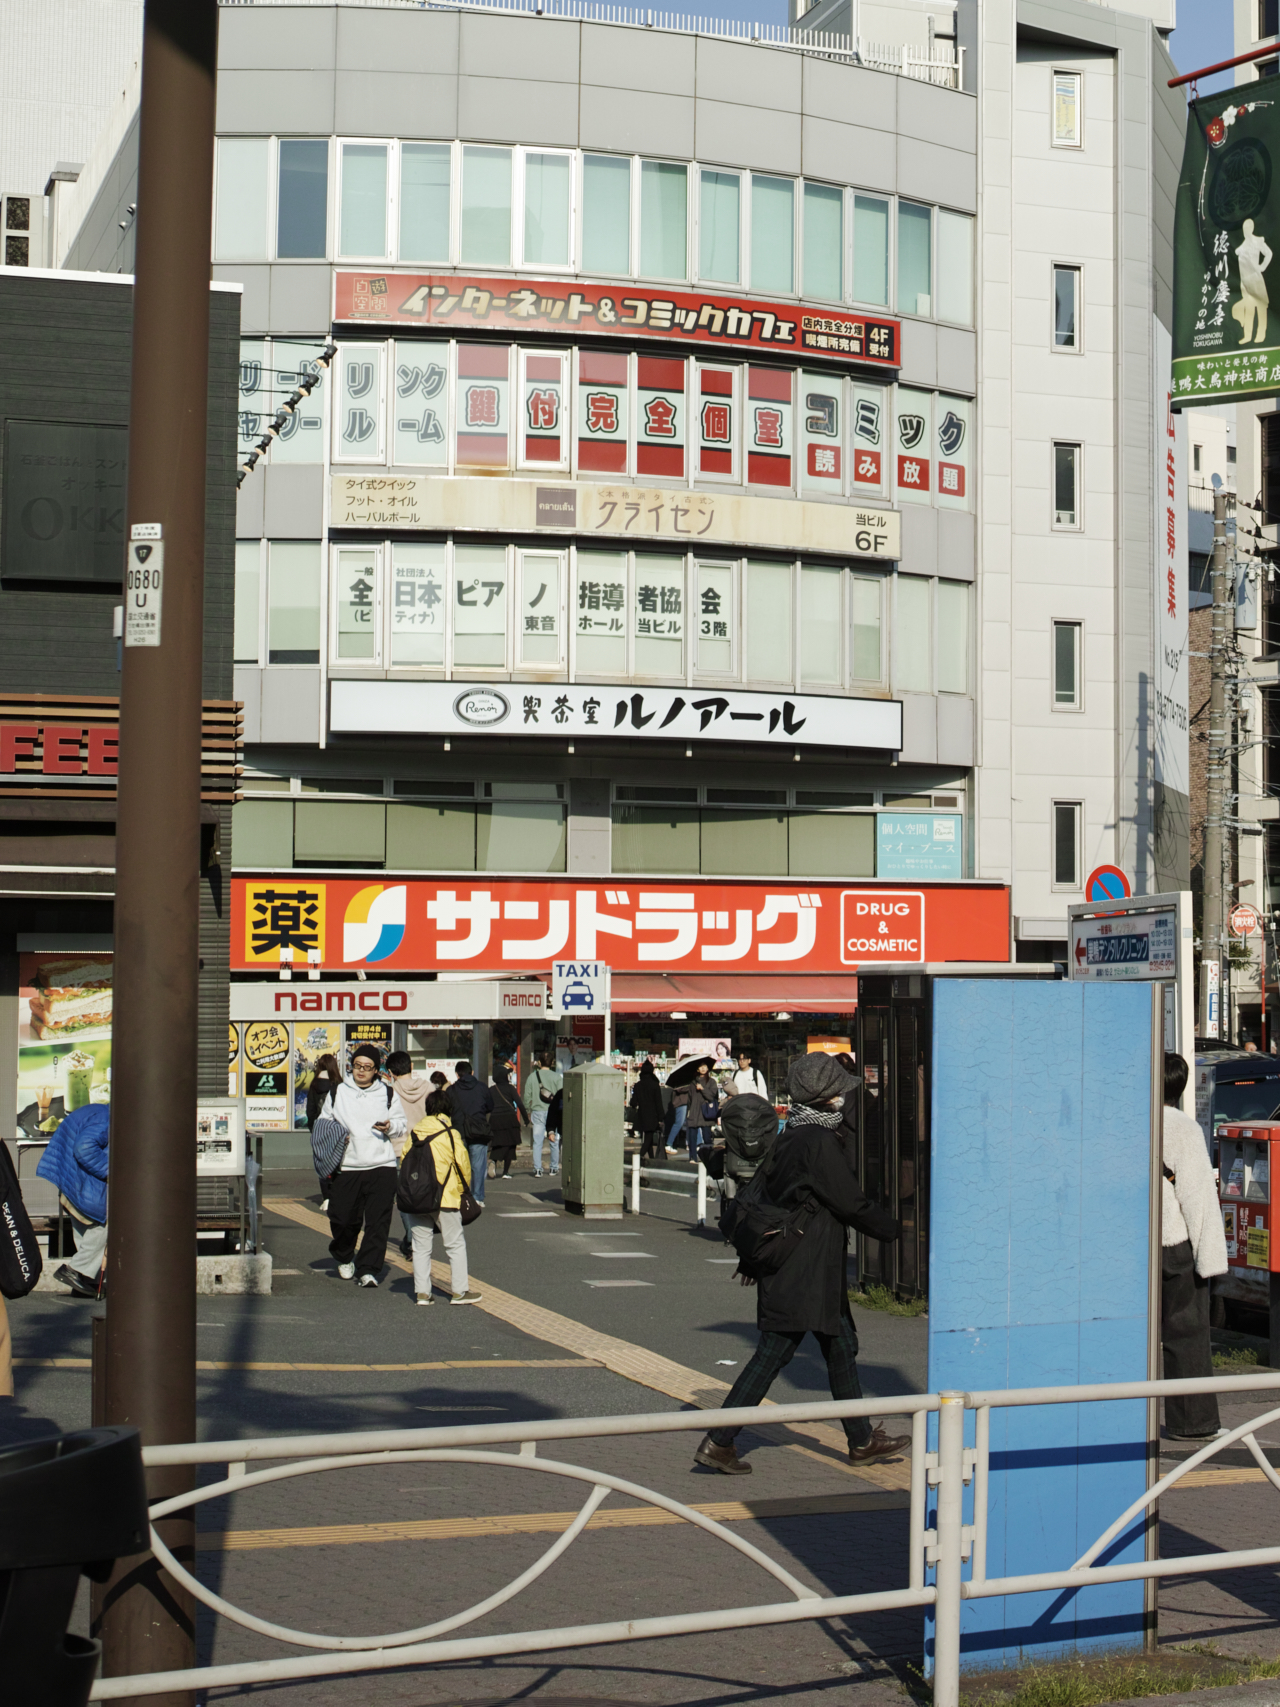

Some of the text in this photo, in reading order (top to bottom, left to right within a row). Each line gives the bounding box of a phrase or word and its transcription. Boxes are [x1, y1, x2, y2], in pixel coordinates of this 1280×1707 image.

[870, 327, 889, 343] 4F
[1194, 332, 1223, 341] YOSHINOBU
[869, 343, 889, 358] 受付
[1193, 339, 1223, 348] TOKUGAWA
[466, 385, 783, 449] 鍵付完全個室
[805, 393, 966, 456] コミック
[814, 448, 959, 492] 読み放題
[345, 479, 417, 492] タイ式クイック
[345, 495, 418, 508] フット・オイル
[345, 511, 421, 525] ハーバルボール
[595, 501, 715, 536] クライセン
[855, 513, 887, 529] 当ビル
[854, 530, 888, 553] 6F
[139, 549, 148, 558] 17
[127, 569, 160, 590] 0680
[135, 593, 147, 608] U
[349, 578, 722, 617] 全日本ピアノ指導者協会
[522, 692, 808, 736] 喫茶室 ルノアール
[881, 822, 928, 836] 個人空間
[855, 902, 911, 916] DRUG
[250, 887, 320, 959] 薬
[426, 888, 824, 962] サンドラッグ
[878, 923, 890, 935] &
[846, 938, 919, 953] COSMETIC
[555, 964, 599, 978] TAXI
[274, 990, 408, 1012] namco
[503, 993, 543, 1007] namco
[1, 1201, 16, 1230] DEAN
[12, 1238, 30, 1282] DELUCA
